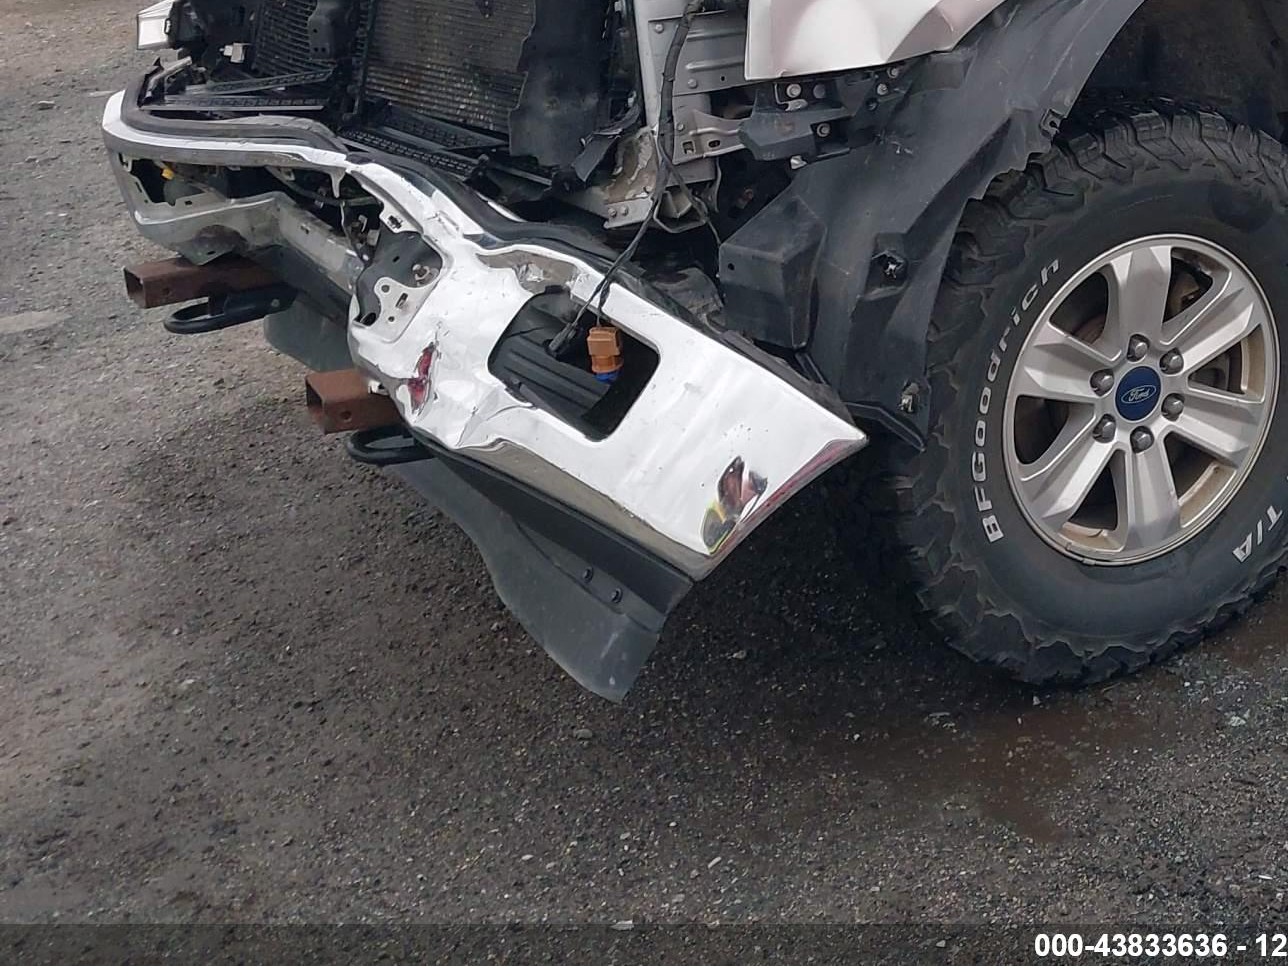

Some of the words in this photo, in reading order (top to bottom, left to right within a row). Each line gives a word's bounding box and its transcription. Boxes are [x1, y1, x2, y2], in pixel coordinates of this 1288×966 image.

[971, 258, 1060, 543] BFGoodrich
[1128, 388, 1151, 402] Ford
[1232, 504, 1284, 563] T/A
